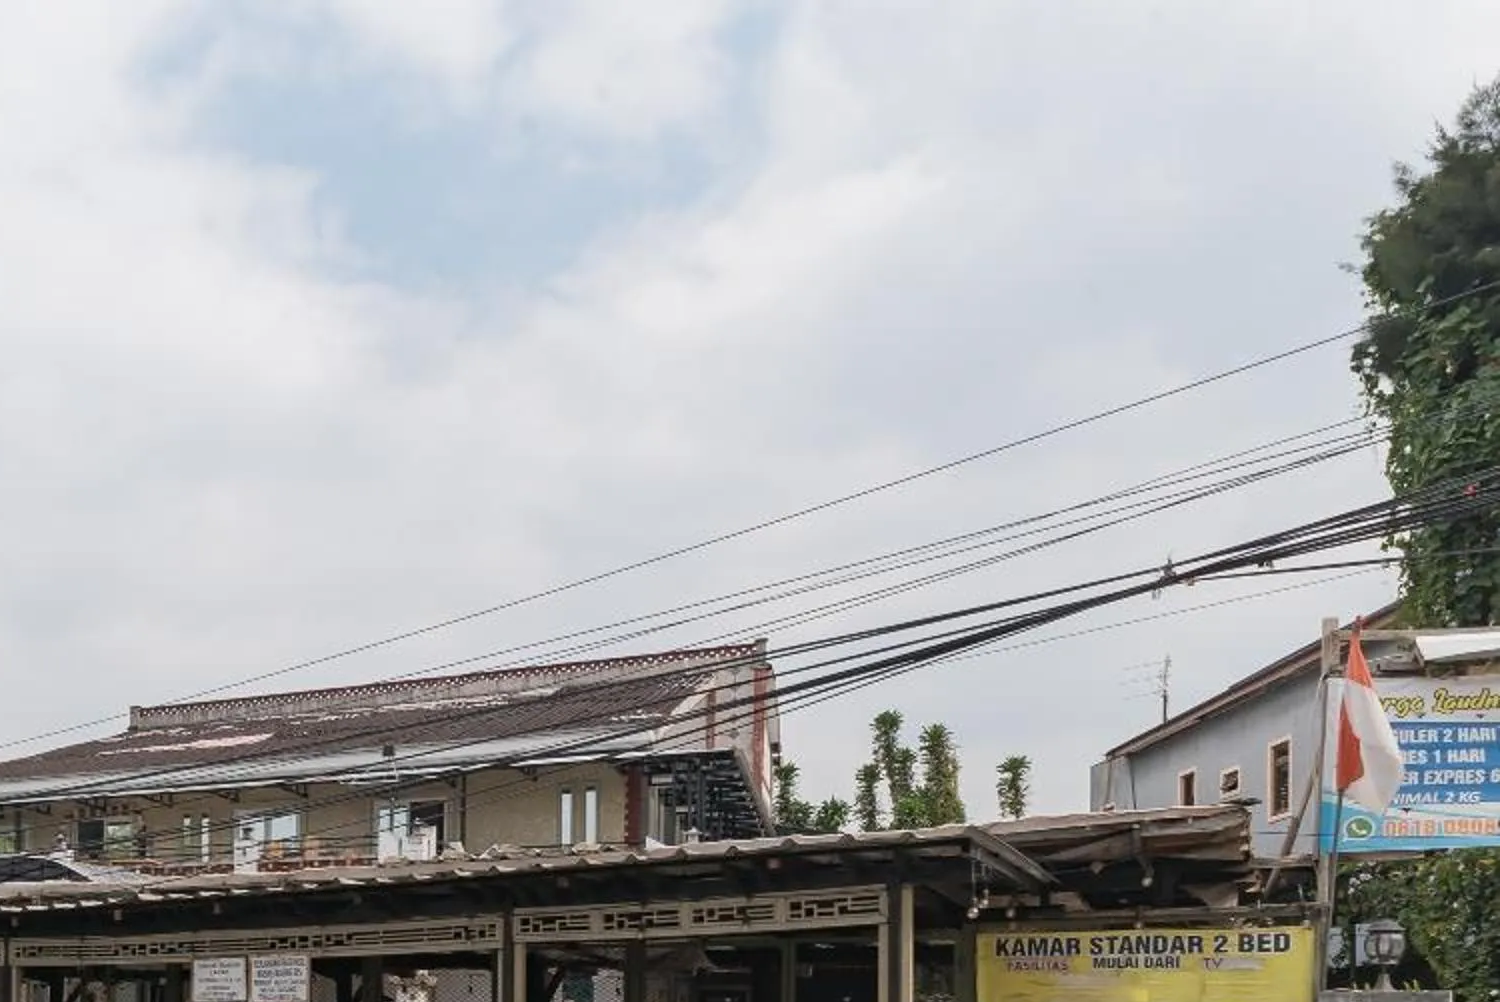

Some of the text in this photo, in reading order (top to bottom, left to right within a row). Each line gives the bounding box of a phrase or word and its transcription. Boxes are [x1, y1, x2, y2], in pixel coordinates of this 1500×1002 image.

[1443, 727, 1453, 743] 2
[1457, 727, 1497, 743] HARI
[1433, 749, 1441, 764] 1
[1446, 747, 1486, 764] HARI
[1423, 768, 1486, 785] EXPRES
[1443, 790, 1455, 803] 2
[1459, 790, 1481, 804] KG
[995, 933, 1291, 957] KAMAR STANDAR 2 BED
[1092, 956, 1180, 970] MULAI DARI
